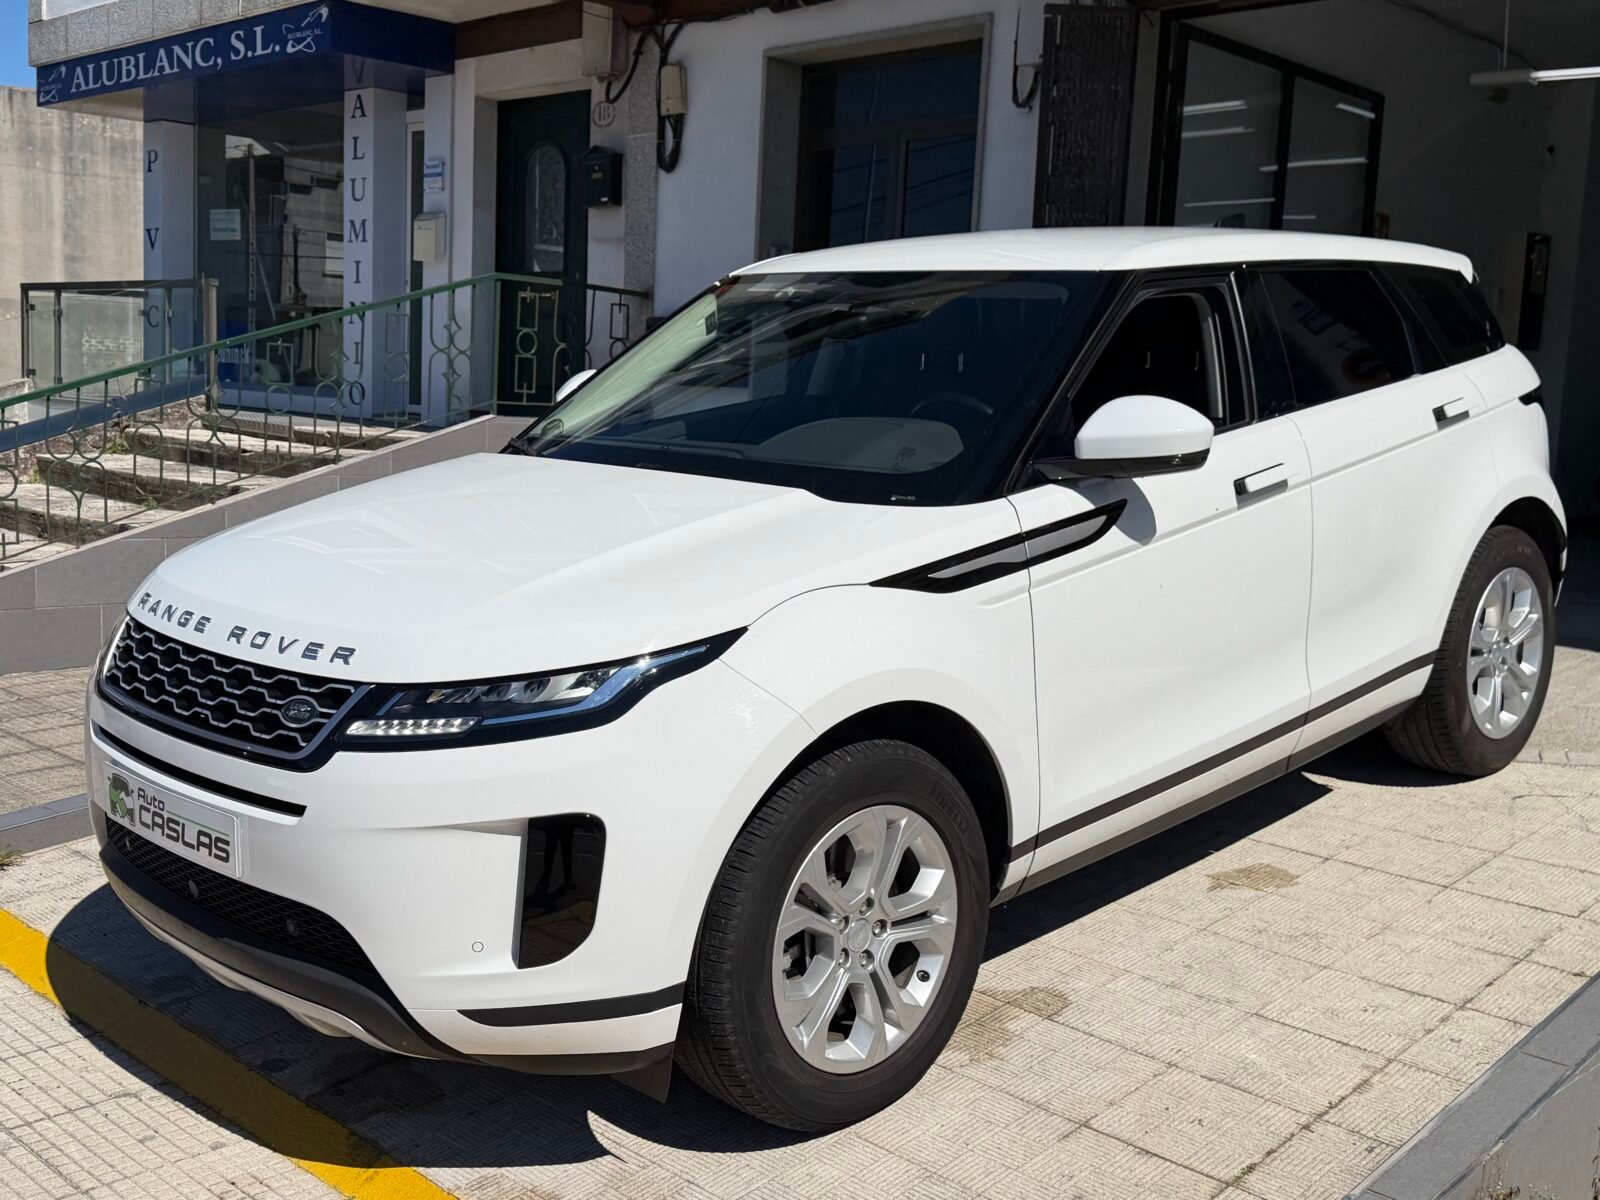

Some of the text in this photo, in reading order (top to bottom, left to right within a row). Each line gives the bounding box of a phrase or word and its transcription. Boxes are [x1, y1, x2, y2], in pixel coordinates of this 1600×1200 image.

[70, 24, 281, 93] ALUBLANC, S.L.
[138, 592, 357, 666] RANGE ROVER
[137, 787, 165, 811] Auto
[138, 804, 231, 864] CASLAS
